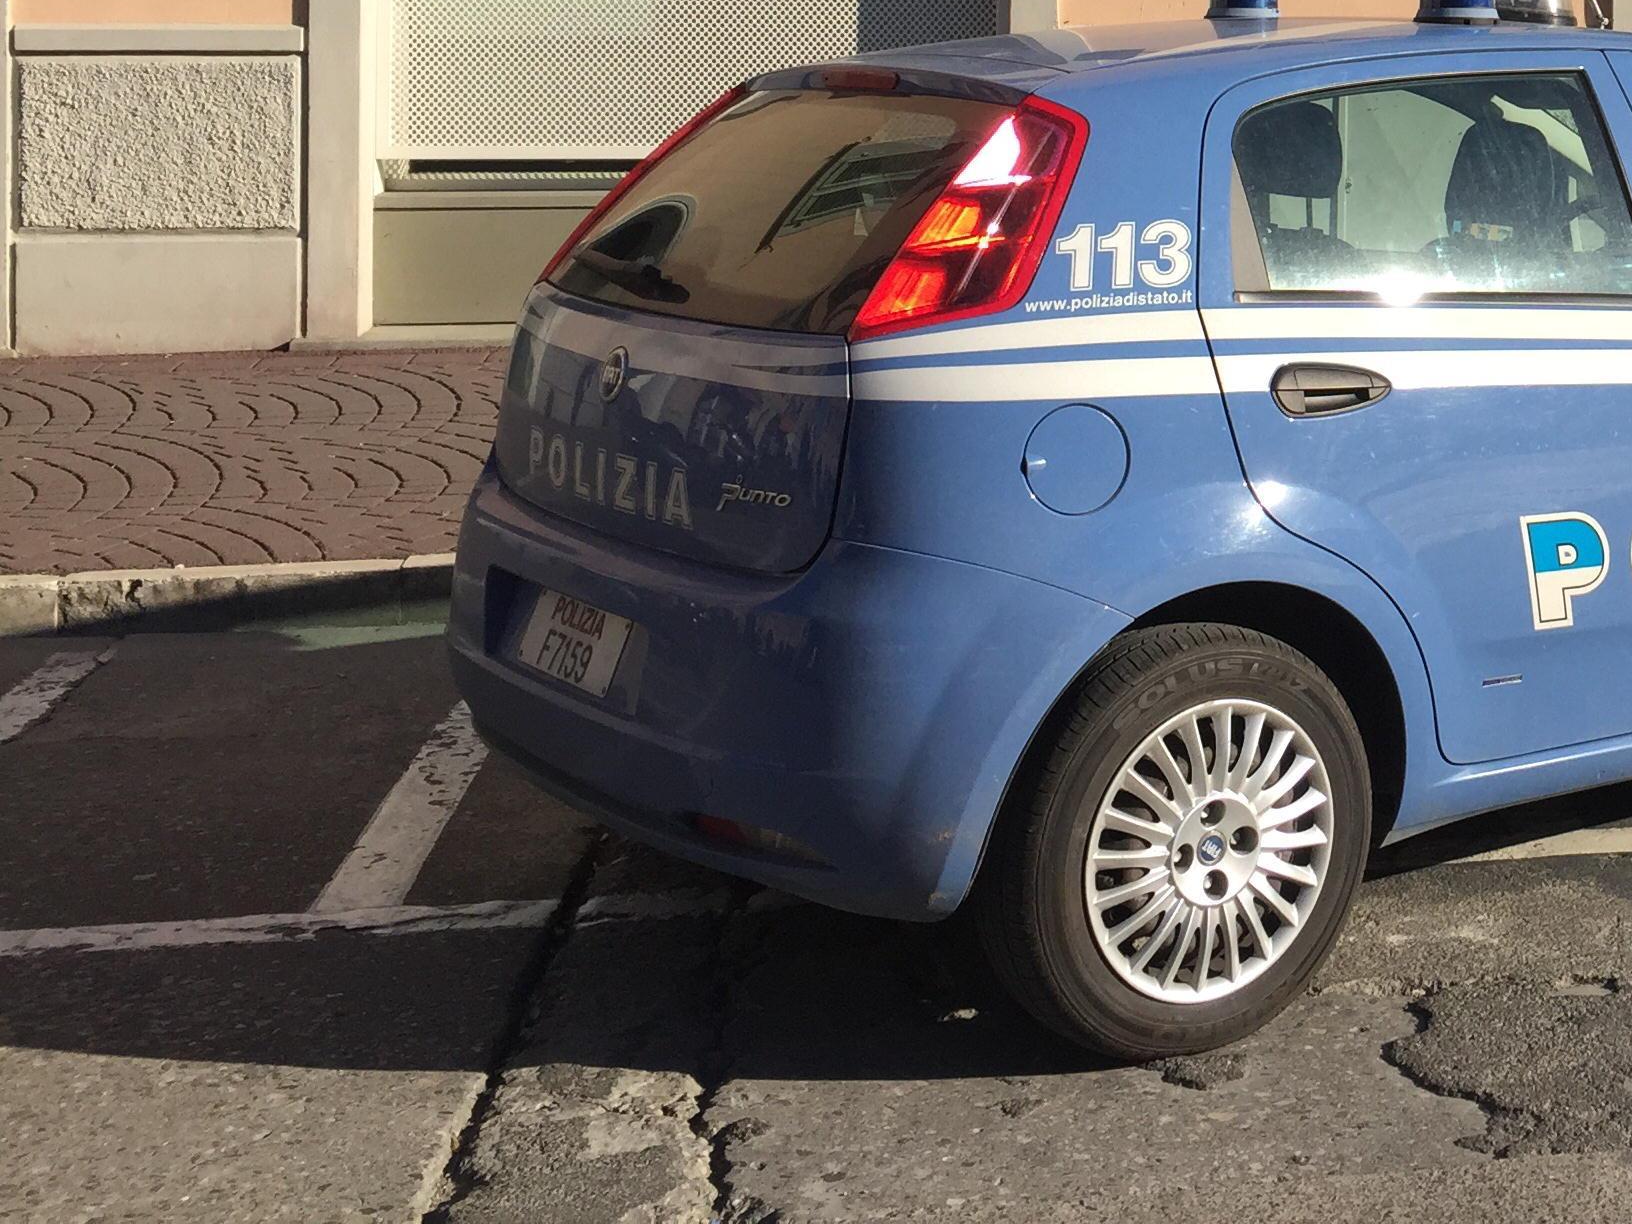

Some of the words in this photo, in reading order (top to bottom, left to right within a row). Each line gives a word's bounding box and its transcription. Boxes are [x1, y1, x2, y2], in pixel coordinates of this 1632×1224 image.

[1055, 218, 1193, 292] 113
[1025, 289, 1193, 313] www.poliziadistato.it
[528, 424, 694, 530] POLIZIA
[551, 595, 606, 641] POLIZIA
[536, 628, 593, 684] F7159
